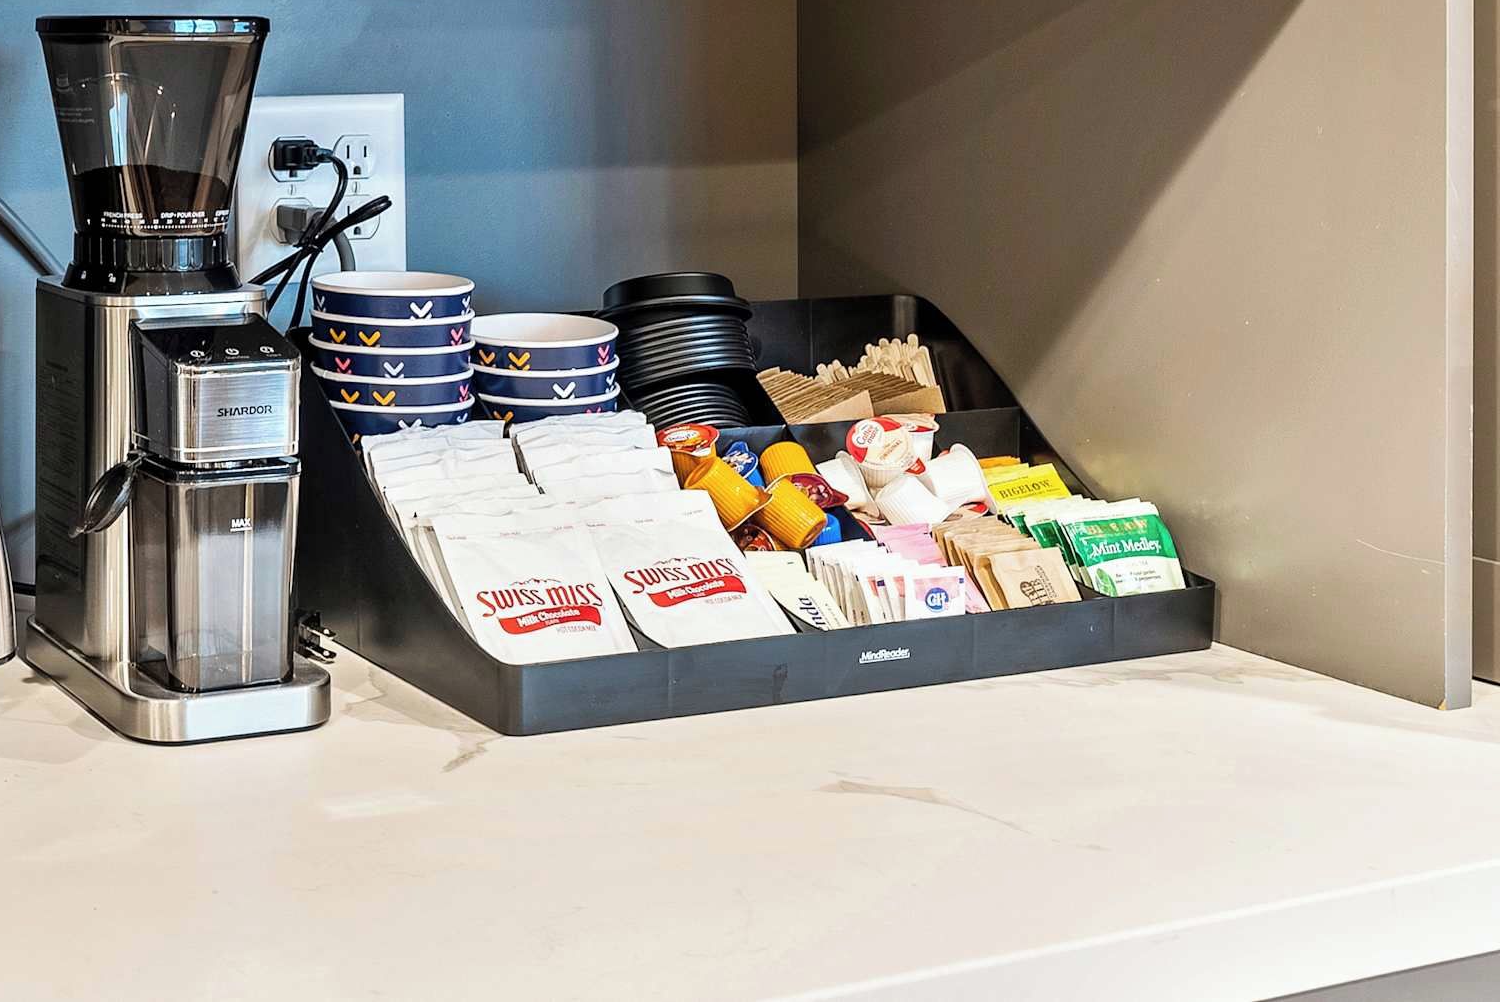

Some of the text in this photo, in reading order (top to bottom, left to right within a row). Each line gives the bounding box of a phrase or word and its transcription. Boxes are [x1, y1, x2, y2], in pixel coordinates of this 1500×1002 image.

[216, 404, 274, 417] SHARDOR
[999, 478, 1051, 499] BIGELOW
[231, 517, 251, 528] MAX
[1089, 538, 1121, 558] Mint
[624, 566, 690, 594] SWISS
[476, 588, 546, 617] SWISS
[516, 614, 539, 628] Milk
[537, 608, 581, 622] Chocolate
[861, 647, 910, 661] MindReader
